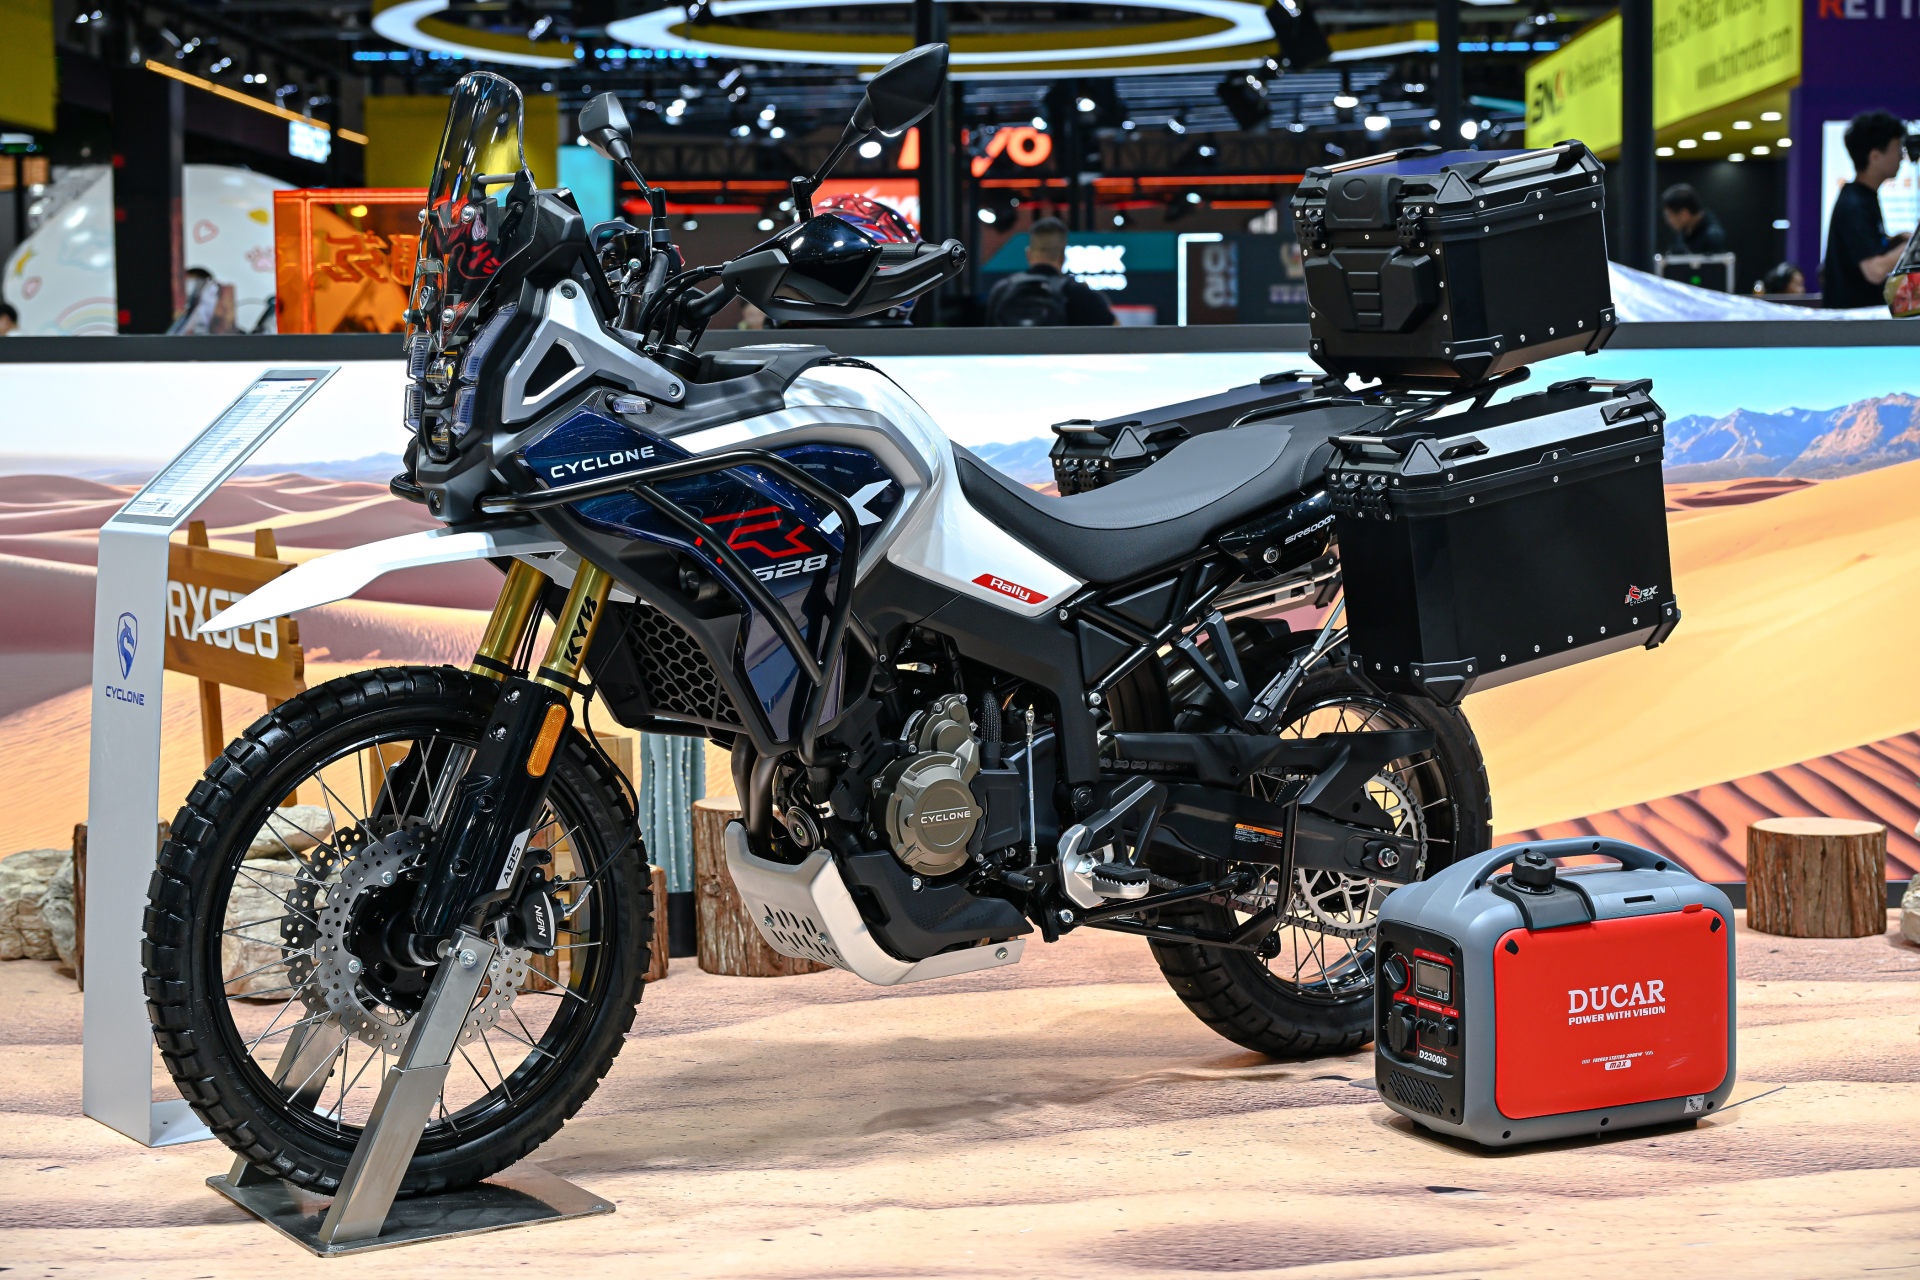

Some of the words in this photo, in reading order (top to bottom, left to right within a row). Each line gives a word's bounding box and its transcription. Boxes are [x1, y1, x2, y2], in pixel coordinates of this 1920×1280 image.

[550, 445, 655, 479] CYCLONE
[990, 577, 1031, 601] Rally
[564, 596, 598, 666] KYB
[105, 685, 145, 706] CYCLONE
[920, 810, 971, 824] CYCLONE
[503, 844, 521, 884] ABS
[1568, 979, 1666, 1014] DUCAR
[1568, 1013, 1605, 1026] POWER
[1605, 1009, 1631, 1021] WITH
[1632, 1005, 1666, 1017] VISION
[1418, 1049, 1448, 1066] D2300iS
